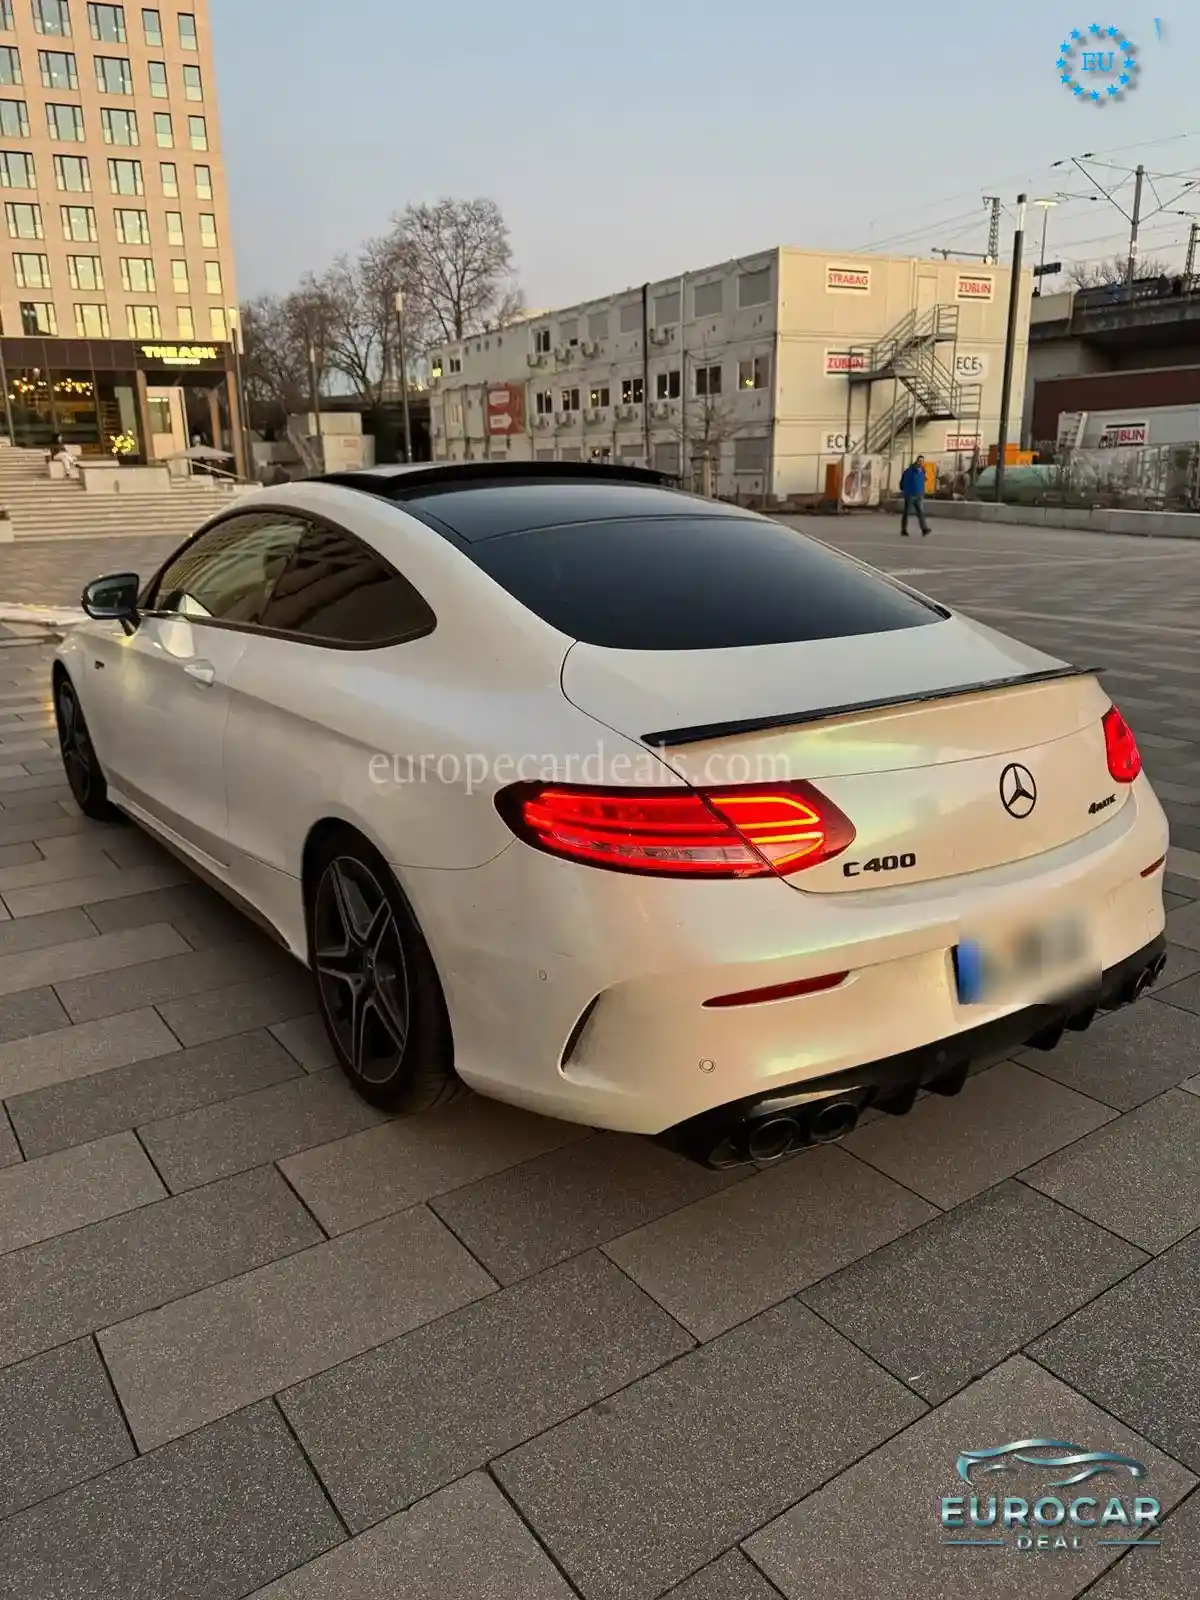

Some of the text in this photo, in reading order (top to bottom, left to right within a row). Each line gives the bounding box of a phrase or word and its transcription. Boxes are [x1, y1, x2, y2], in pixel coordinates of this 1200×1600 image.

[828, 272, 869, 286] STRABAG
[141, 346, 177, 358] THE
[843, 853, 916, 877] C 400
